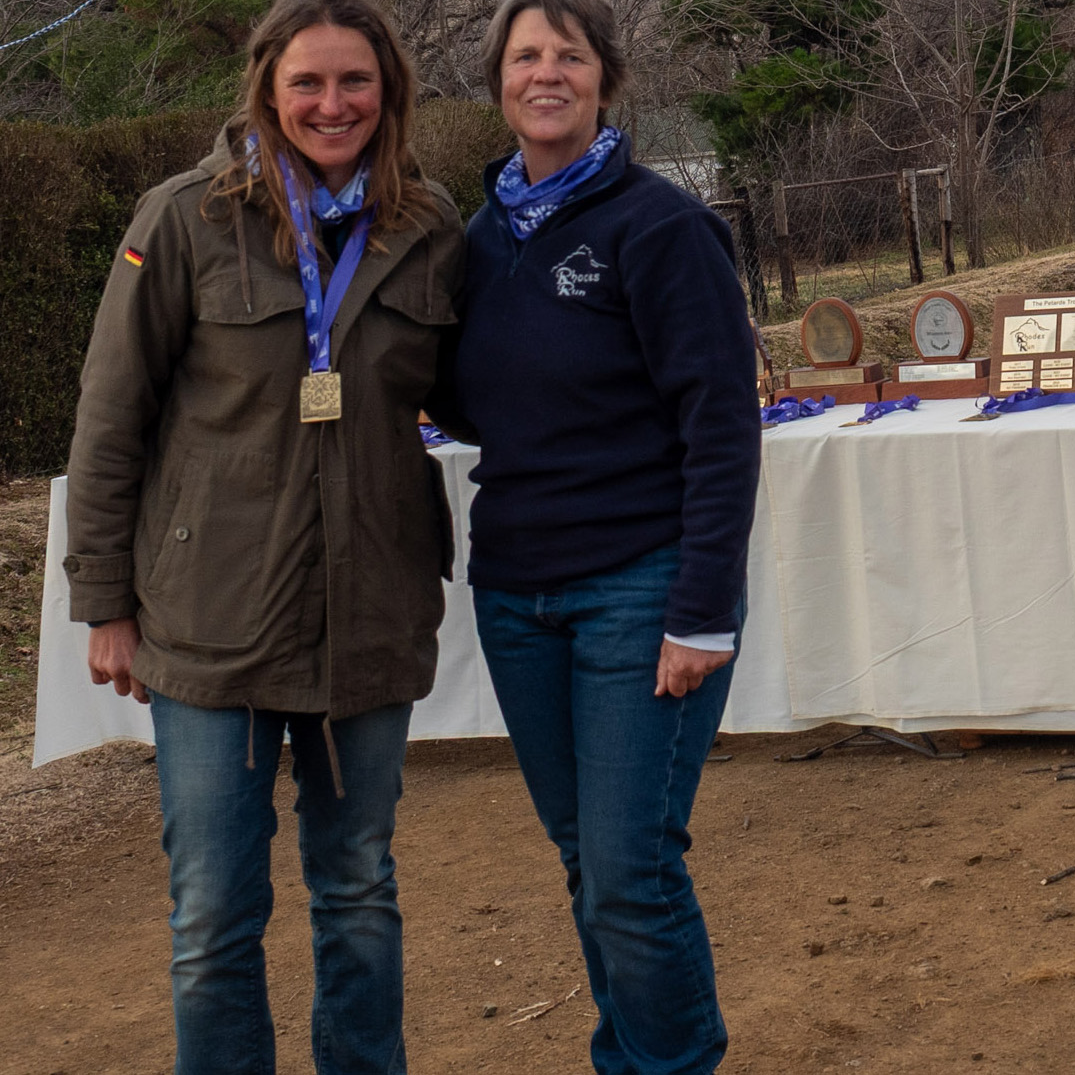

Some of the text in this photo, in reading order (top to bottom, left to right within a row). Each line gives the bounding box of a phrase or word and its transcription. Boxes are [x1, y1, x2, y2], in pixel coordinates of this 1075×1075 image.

[557, 281, 586, 296] Run
[1014, 331, 1045, 343] Rhodes
[1017, 341, 1036, 352] Run
